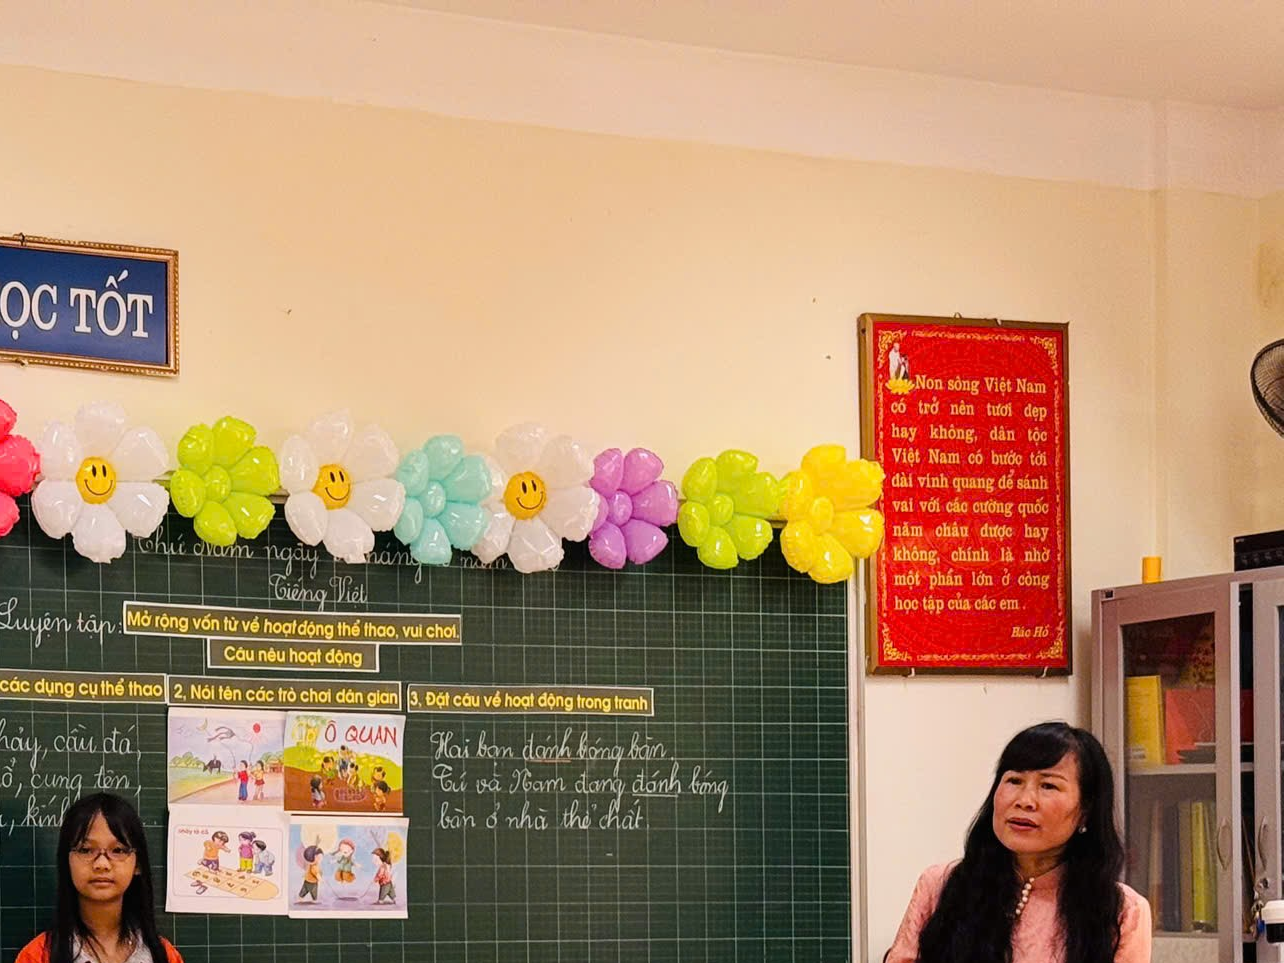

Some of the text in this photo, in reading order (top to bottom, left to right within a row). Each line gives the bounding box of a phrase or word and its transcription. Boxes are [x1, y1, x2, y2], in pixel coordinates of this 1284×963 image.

[70, 269, 153, 339] TỐT
[915, 375, 1047, 396] Non sông Việt Nam
[891, 400, 906, 414] có
[918, 397, 940, 415] trở
[950, 401, 975, 415] nên
[986, 402, 1013, 417] tươi
[891, 423, 1048, 446] hay không, dân tộc
[892, 448, 1048, 467] Việt Nam có bước tới
[918, 473, 949, 489] vinh
[953, 476, 994, 492] quang
[1017, 474, 1048, 490] sánh
[892, 497, 1049, 517] vai với các cường quốc
[893, 521, 923, 537] năm
[935, 522, 969, 538] châu
[1024, 524, 1049, 542] hay
[893, 547, 1050, 564] không, chính là nhờ
[894, 572, 920, 590] một
[972, 571, 993, 586] lớn
[1002, 568, 1011, 586] ở
[1018, 573, 1049, 590] công
[269, 573, 367, 612] Tiếng Việt
[894, 592, 997, 615] học tập của các
[127, 609, 151, 627] Mở
[152, 613, 188, 632] rộng
[192, 612, 220, 630] vốn
[223, 615, 239, 631] từ
[241, 614, 260, 632] về
[264, 617, 297, 635] hoạt
[297, 618, 334, 639] động
[337, 619, 361, 636] thể
[364, 621, 399, 639] thao,
[402, 624, 423, 638] vui
[1011, 626, 1030, 638] Bác
[224, 645, 363, 667] Câu nêu hoạt động
[0, 676, 30, 693] các
[34, 677, 75, 698] dụng
[78, 681, 98, 699] cụ
[100, 677, 125, 696] thể
[128, 680, 163, 697] thao
[191, 684, 215, 700] Nói
[218, 685, 242, 700] tên
[245, 686, 274, 702] các
[278, 687, 296, 702] trò
[300, 687, 332, 703] chơi
[336, 688, 364, 703] dân
[367, 689, 398, 707] gian
[425, 691, 449, 709] Đặt
[453, 692, 480, 707] câu
[484, 690, 501, 708] về
[505, 692, 534, 710] hoạt
[538, 692, 573, 711] động
[577, 695, 611, 713] trong
[614, 695, 648, 710] tranh
[53, 723, 97, 754] cầu
[324, 720, 398, 747] Ô QUAN
[430, 730, 470, 760] Hai
[522, 727, 572, 760] đánh
[576, 730, 625, 776] bóng
[30, 770, 82, 803] cung
[94, 765, 142, 797] tên,
[432, 761, 729, 813] Tú và Nam đang đánh bóng
[437, 801, 476, 830] bàn
[486, 802, 501, 830] ở
[505, 799, 549, 830] nhà
